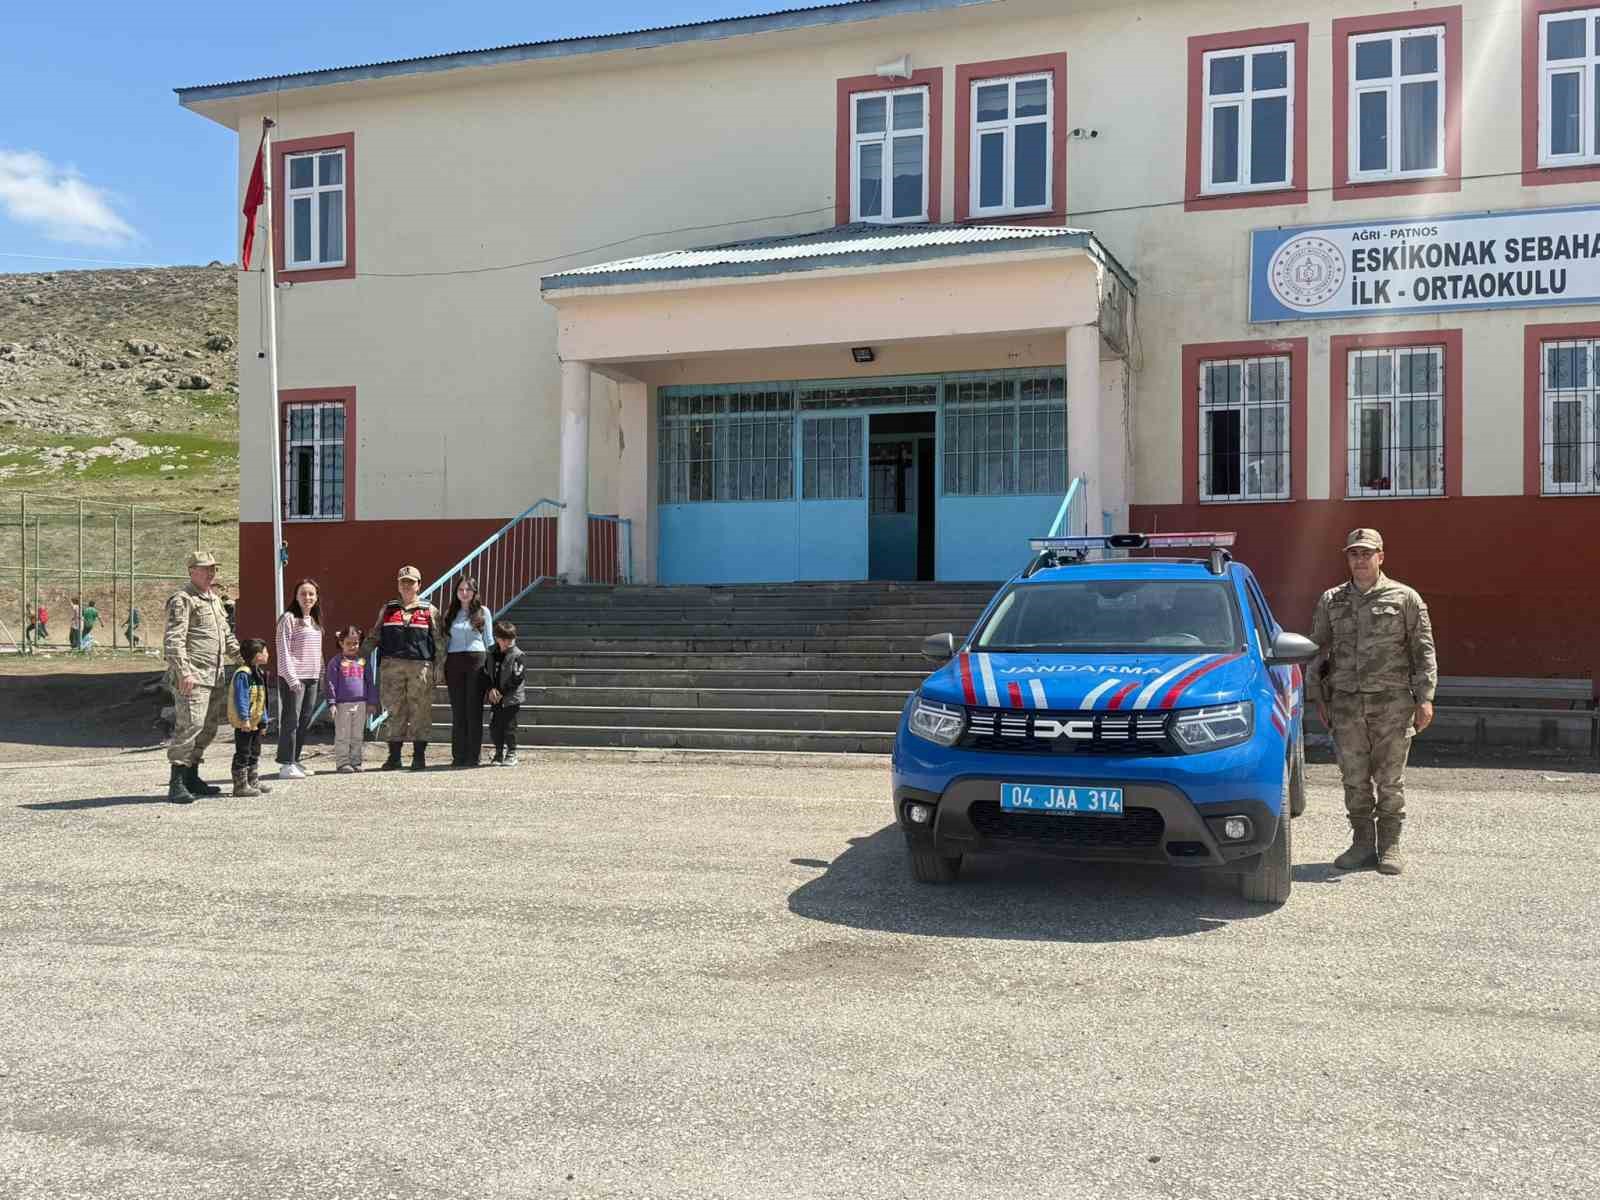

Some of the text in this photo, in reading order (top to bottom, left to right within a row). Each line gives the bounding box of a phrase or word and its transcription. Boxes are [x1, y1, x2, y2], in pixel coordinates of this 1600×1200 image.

[1352, 229, 1380, 241] AĞRI
[1390, 226, 1438, 239] PATNOS
[1352, 239, 1497, 273] ESKİKONAK
[1352, 275, 1392, 305] İLK
[1413, 268, 1567, 302] ORTAOKULU
[1000, 664, 1162, 675] JANDARMA
[1012, 786, 1121, 812] 04 JAA 314
